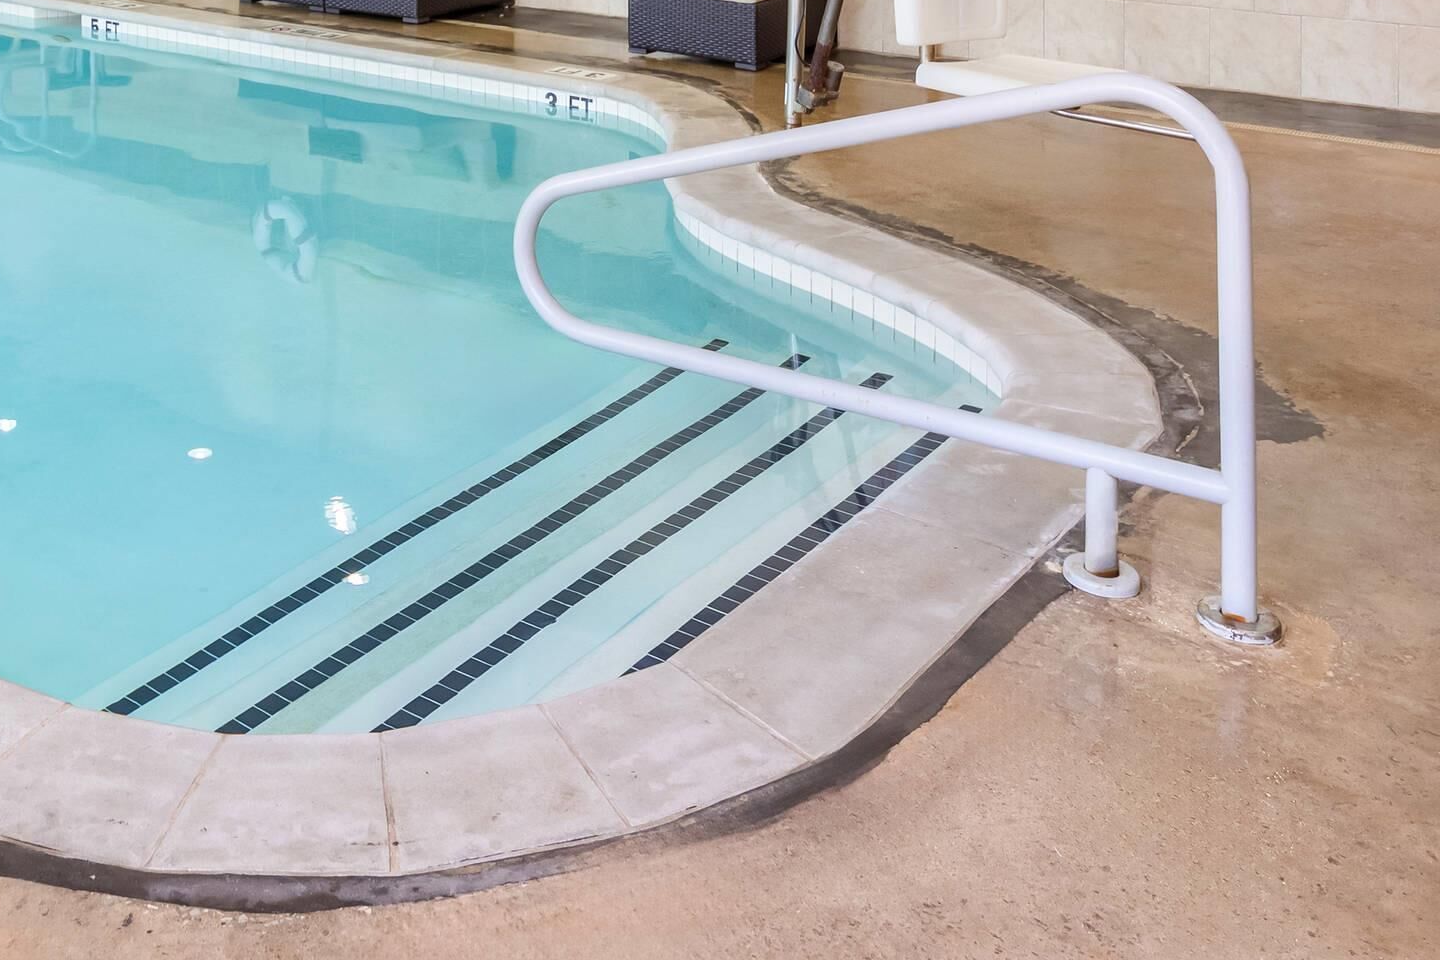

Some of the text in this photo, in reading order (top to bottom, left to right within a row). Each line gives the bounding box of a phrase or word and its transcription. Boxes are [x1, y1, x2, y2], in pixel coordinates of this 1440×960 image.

[105, 20, 120, 38] FT
[544, 92, 594, 116] 3 FT
